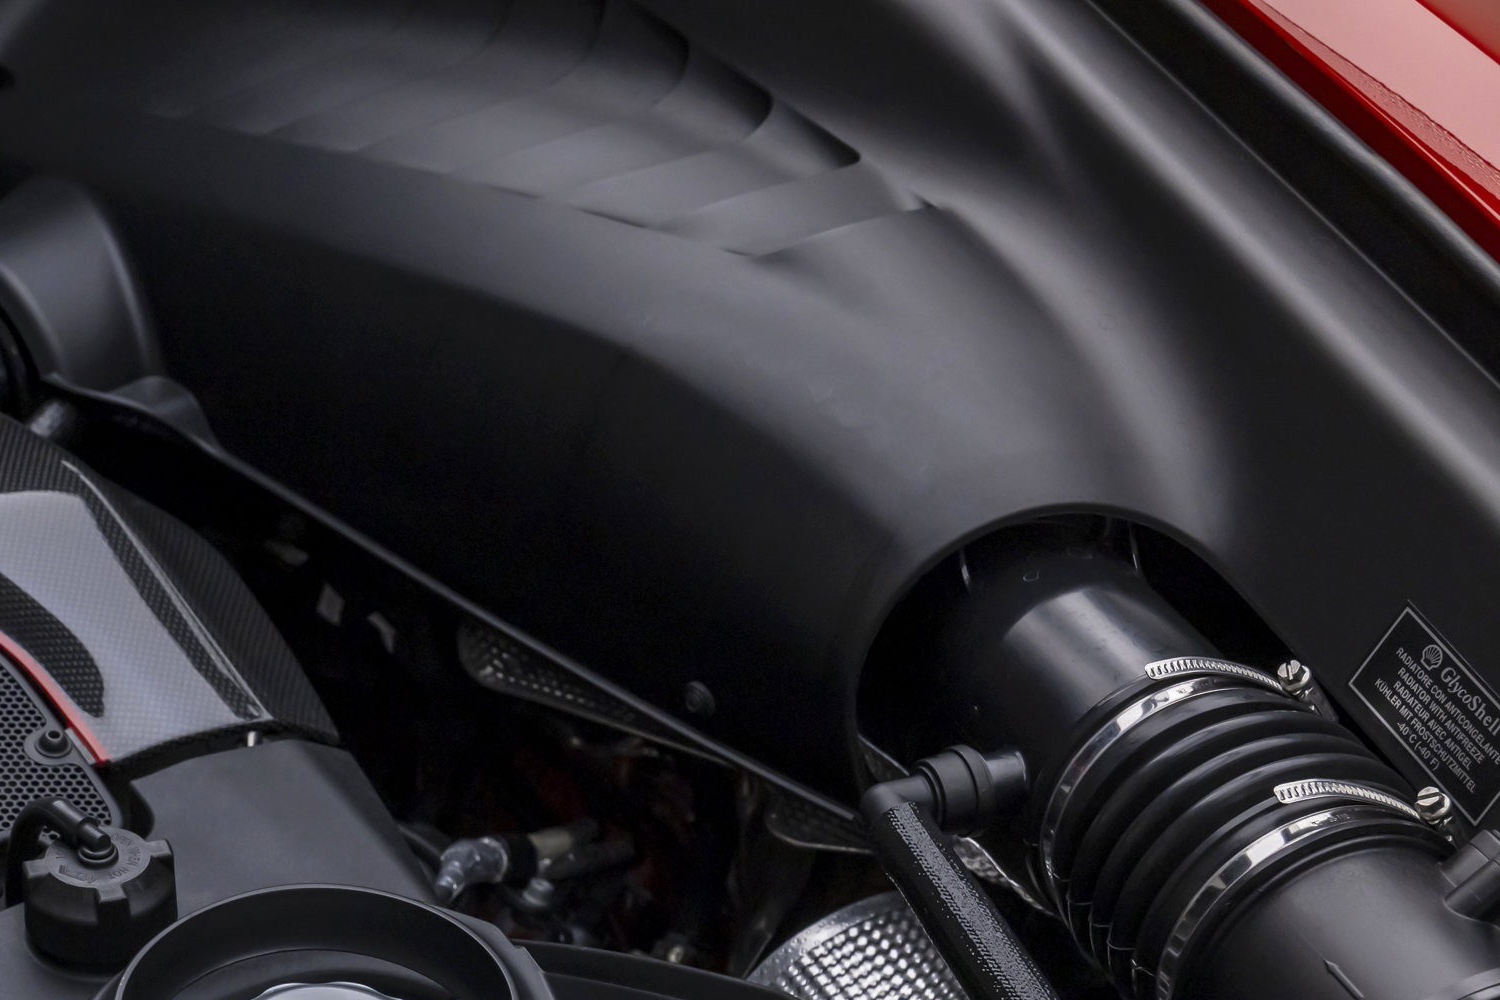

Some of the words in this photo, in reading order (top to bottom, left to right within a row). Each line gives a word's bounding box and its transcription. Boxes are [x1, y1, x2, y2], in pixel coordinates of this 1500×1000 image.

[1375, 678, 1402, 709] KÜHLER
[1399, 705, 1413, 720] MIT
[1410, 718, 1475, 792] FROSTSCHUTZMITTEL
[1393, 681, 1430, 722] RADIATEUR
[1427, 719, 1446, 740] AVEC
[1444, 738, 1471, 770] ANTIGEL
[1396, 648, 1433, 688] RADIATORE
[1431, 685, 1447, 704] CON
[1445, 701, 1500, 764] ANTICONGELANTE
[1398, 667, 1431, 705] RADIATOR
[1429, 701, 1447, 722] WITH
[1444, 720, 1484, 763] ANTIFREEZE
[1441, 667, 1500, 736] GlycoShell
[108, 866, 130, 880] HOT
